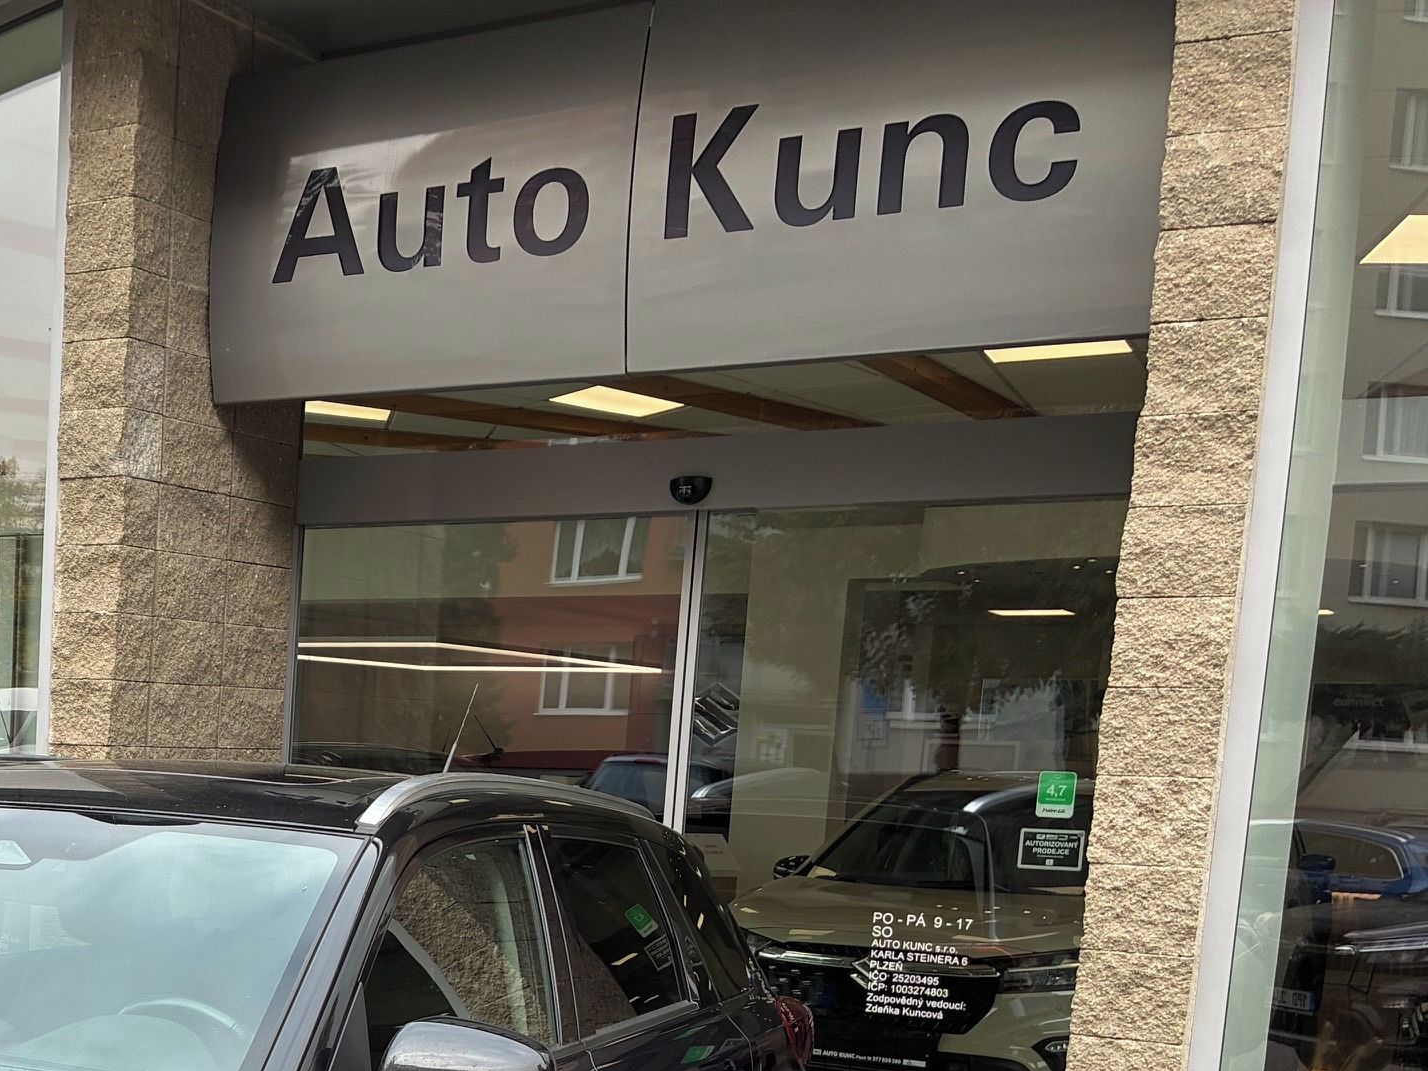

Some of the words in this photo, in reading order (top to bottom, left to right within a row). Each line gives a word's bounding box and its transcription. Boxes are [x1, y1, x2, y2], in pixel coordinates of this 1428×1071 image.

[272, 156, 590, 284] Auto
[663, 99, 1081, 240] Kunc
[1046, 784, 1067, 798] 4,7
[1025, 839, 1079, 849] AUTORIZOVANÝ
[1032, 847, 1070, 856] PRODEJCE
[872, 911, 894, 925] PO
[906, 912, 926, 927] PÁ
[933, 916, 943, 929] 9
[956, 918, 973, 930] 17
[872, 925, 893, 938] SO
[871, 938, 901, 949] AUTO
[903, 941, 933, 952] KUNC
[934, 945, 959, 954] s.r.o.
[870, 949, 904, 961] KARLA
[906, 953, 960, 966] STEINERA
[961, 956, 968, 967] 6
[869, 960, 903, 971] PLZEŇ
[892, 973, 940, 986] 25203495
[891, 984, 949, 998] 1003274803
[866, 992, 924, 1008] Zodpovědný
[925, 1000, 967, 1011] vedoucí:
[865, 1003, 900, 1016] Zdeňka
[902, 1007, 944, 1019] Kuncová
